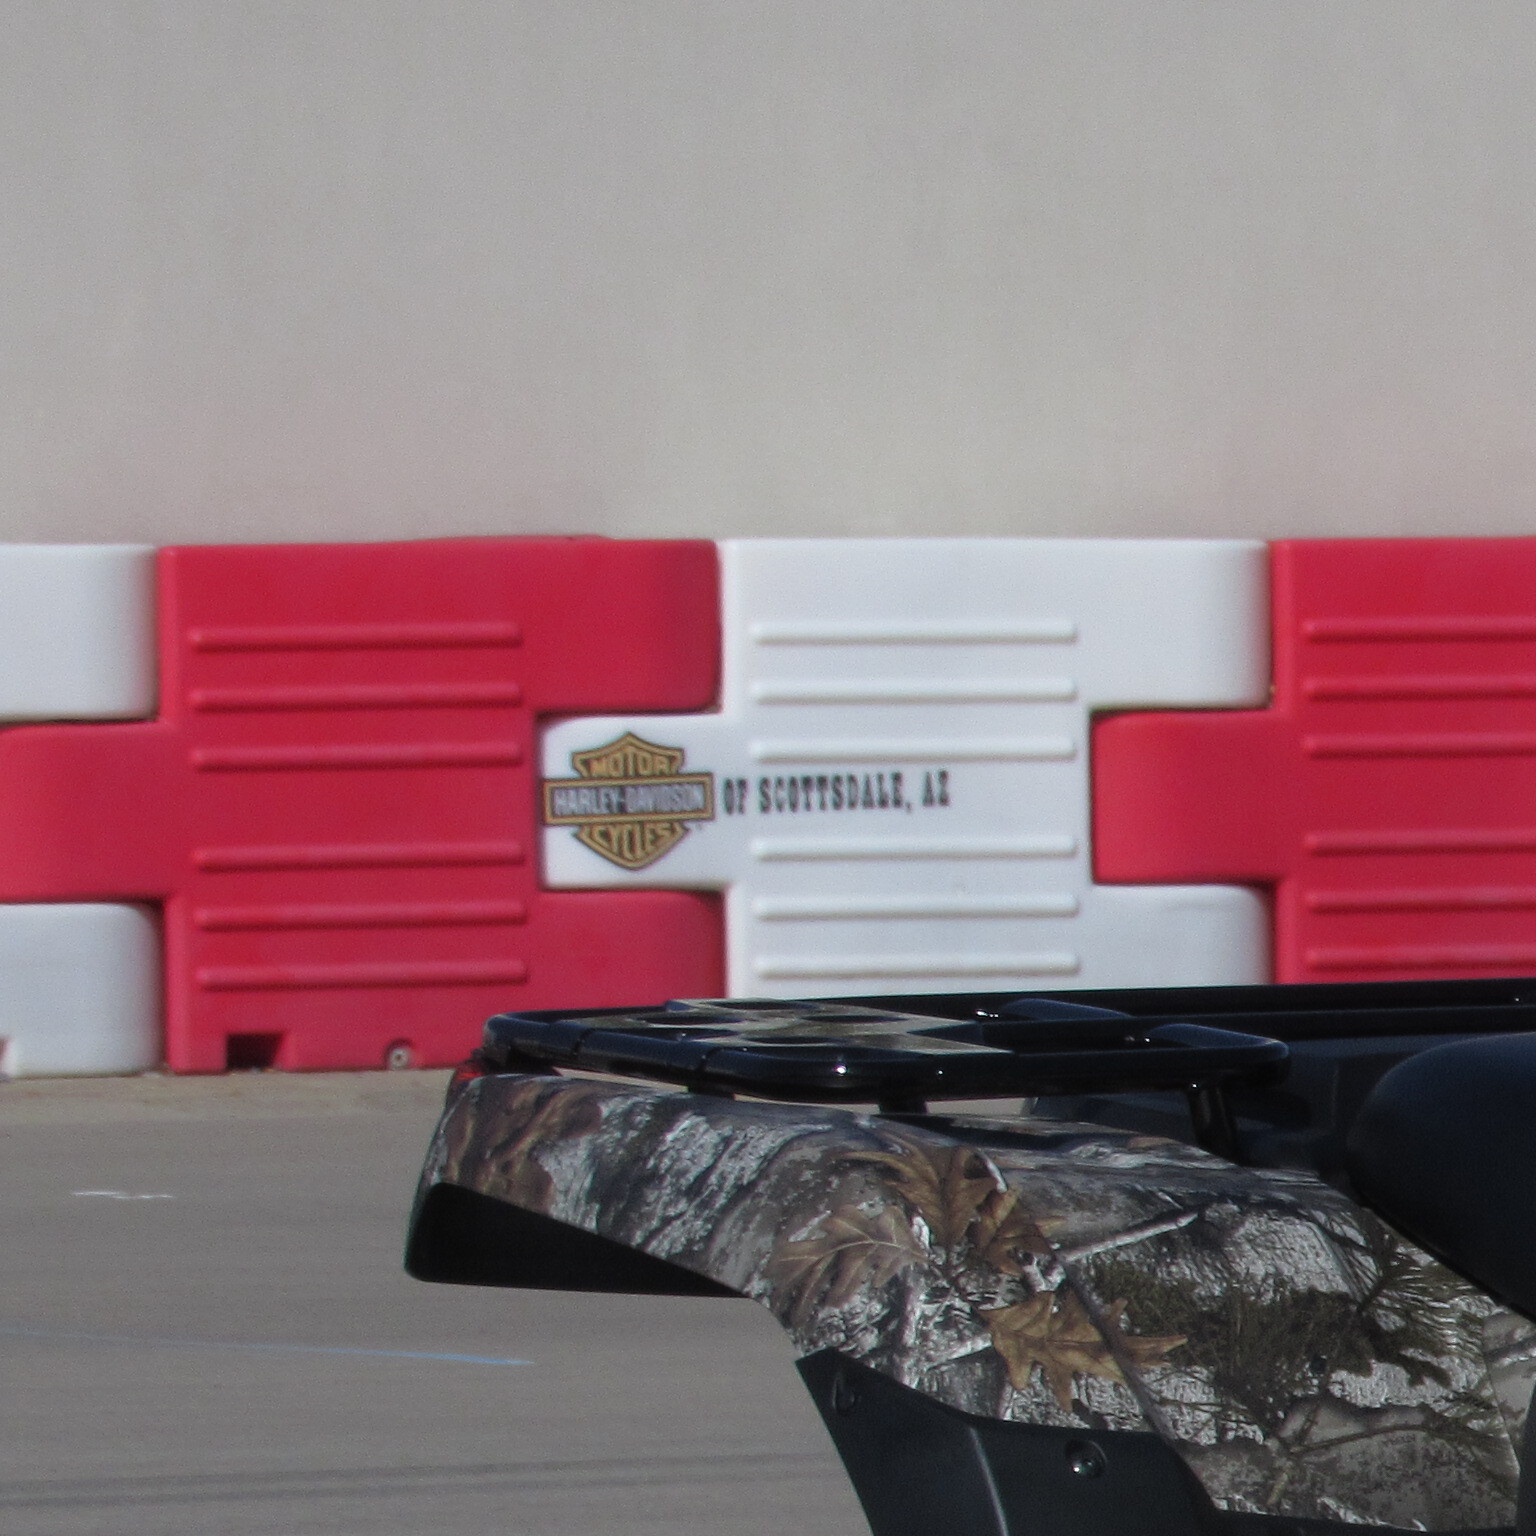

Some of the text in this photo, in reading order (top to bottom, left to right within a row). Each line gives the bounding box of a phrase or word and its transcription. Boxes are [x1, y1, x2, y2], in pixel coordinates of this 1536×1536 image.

[592, 752, 671, 778] MOTOR
[551, 781, 704, 818] HARLEY-DAVIDSON
[722, 769, 952, 815] OF SCOTTSDALE, AZ
[594, 821, 677, 860] CYCLES
